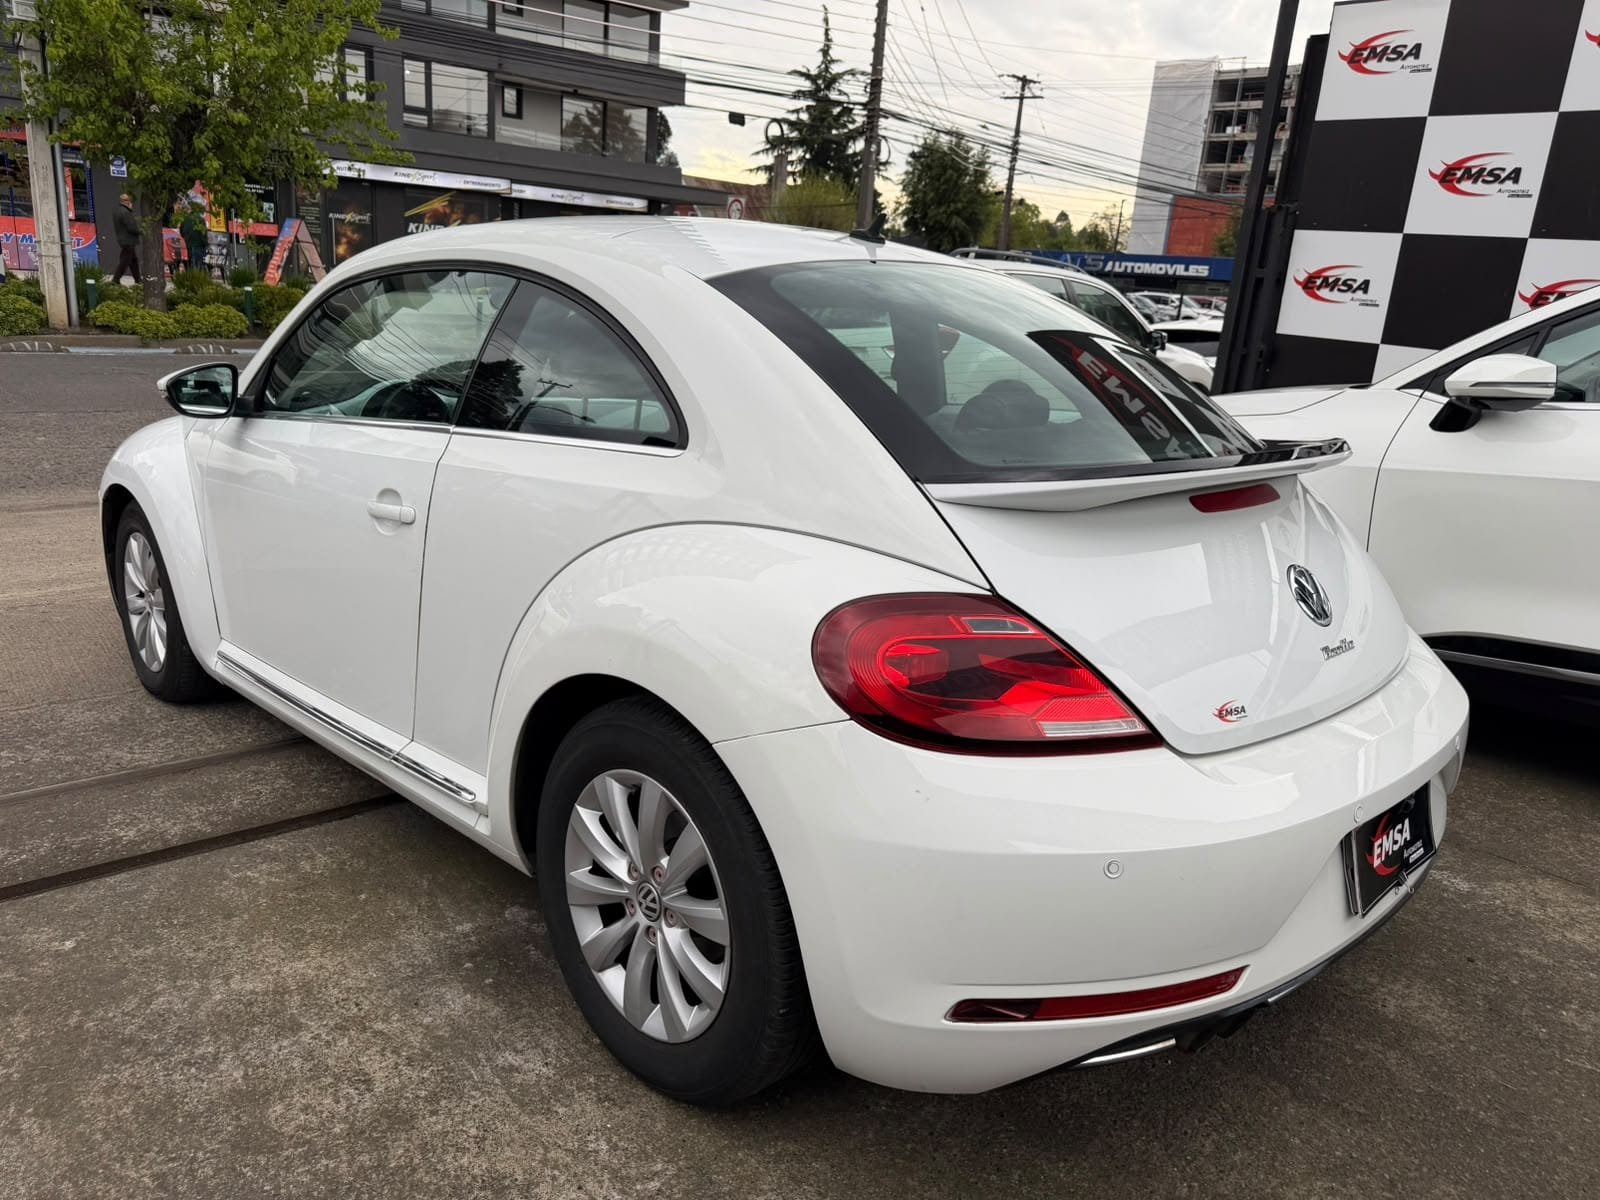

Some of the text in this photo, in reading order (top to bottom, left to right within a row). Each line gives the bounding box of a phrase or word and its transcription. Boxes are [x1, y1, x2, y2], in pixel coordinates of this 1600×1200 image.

[1347, 43, 1423, 64] EMSA
[1438, 166, 1523, 185] EMSA
[1104, 261, 1210, 277] AUTOMOVILES
[1302, 275, 1371, 295] EMSA
[1218, 705, 1246, 718] EMSA
[1373, 817, 1411, 869] EMSA
